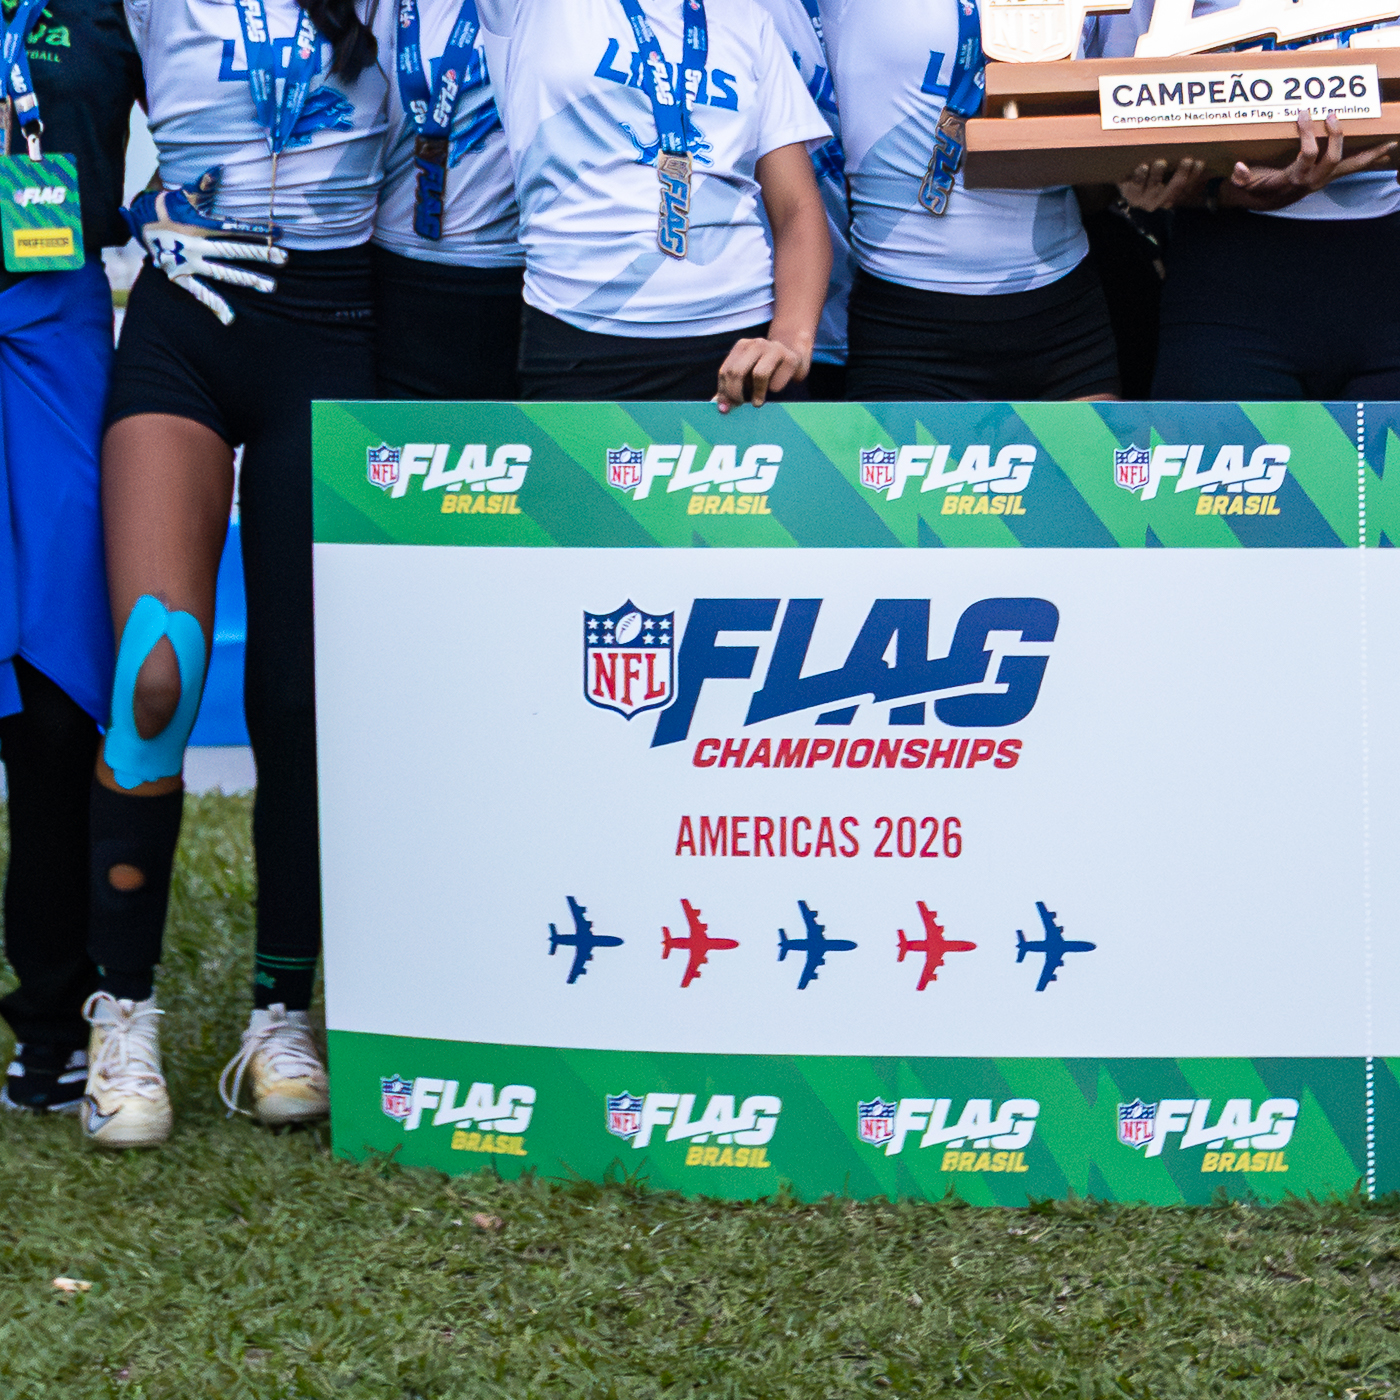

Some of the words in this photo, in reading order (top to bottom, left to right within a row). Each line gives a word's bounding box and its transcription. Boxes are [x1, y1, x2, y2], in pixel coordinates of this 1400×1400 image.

[647, 59, 674, 106] FLAG
[1112, 73, 1274, 107] CAMPEÃO
[1282, 75, 1367, 101] 2026
[1112, 113, 1181, 125] Campeonato
[1184, 110, 1231, 120] Nacional
[1234, 110, 1248, 118] de
[1251, 109, 1274, 119] Flag
[22, 187, 66, 207] FLAG
[370, 463, 398, 484] NFL
[391, 443, 532, 499] FLAG
[611, 464, 641, 485] NFL
[633, 444, 784, 500] FLAG
[864, 464, 894, 485] NFL
[886, 444, 1037, 500] FLAG
[1118, 465, 1148, 485] NFL
[1140, 444, 1291, 501] FLAG
[440, 494, 521, 515] BRASIL
[687, 494, 772, 515] BRASIL
[941, 494, 1026, 515] BRASIL
[1195, 494, 1281, 515] BRASIL
[592, 650, 667, 707] NFL
[650, 597, 1060, 748] FLAG
[692, 737, 1023, 769] CHAMPIONSHIPS
[675, 815, 860, 858] AMERICAS
[874, 816, 963, 859] 2026
[404, 1078, 536, 1132] FLAG
[633, 1093, 782, 1149] FLAG
[451, 1130, 528, 1156] BRASIL
[886, 1098, 1040, 1155] FLAG
[1145, 1099, 1299, 1158] FLAG
[685, 1145, 771, 1169] BRASIL
[941, 1151, 1029, 1173] BRASIL
[1201, 1151, 1289, 1173] BRASIL
